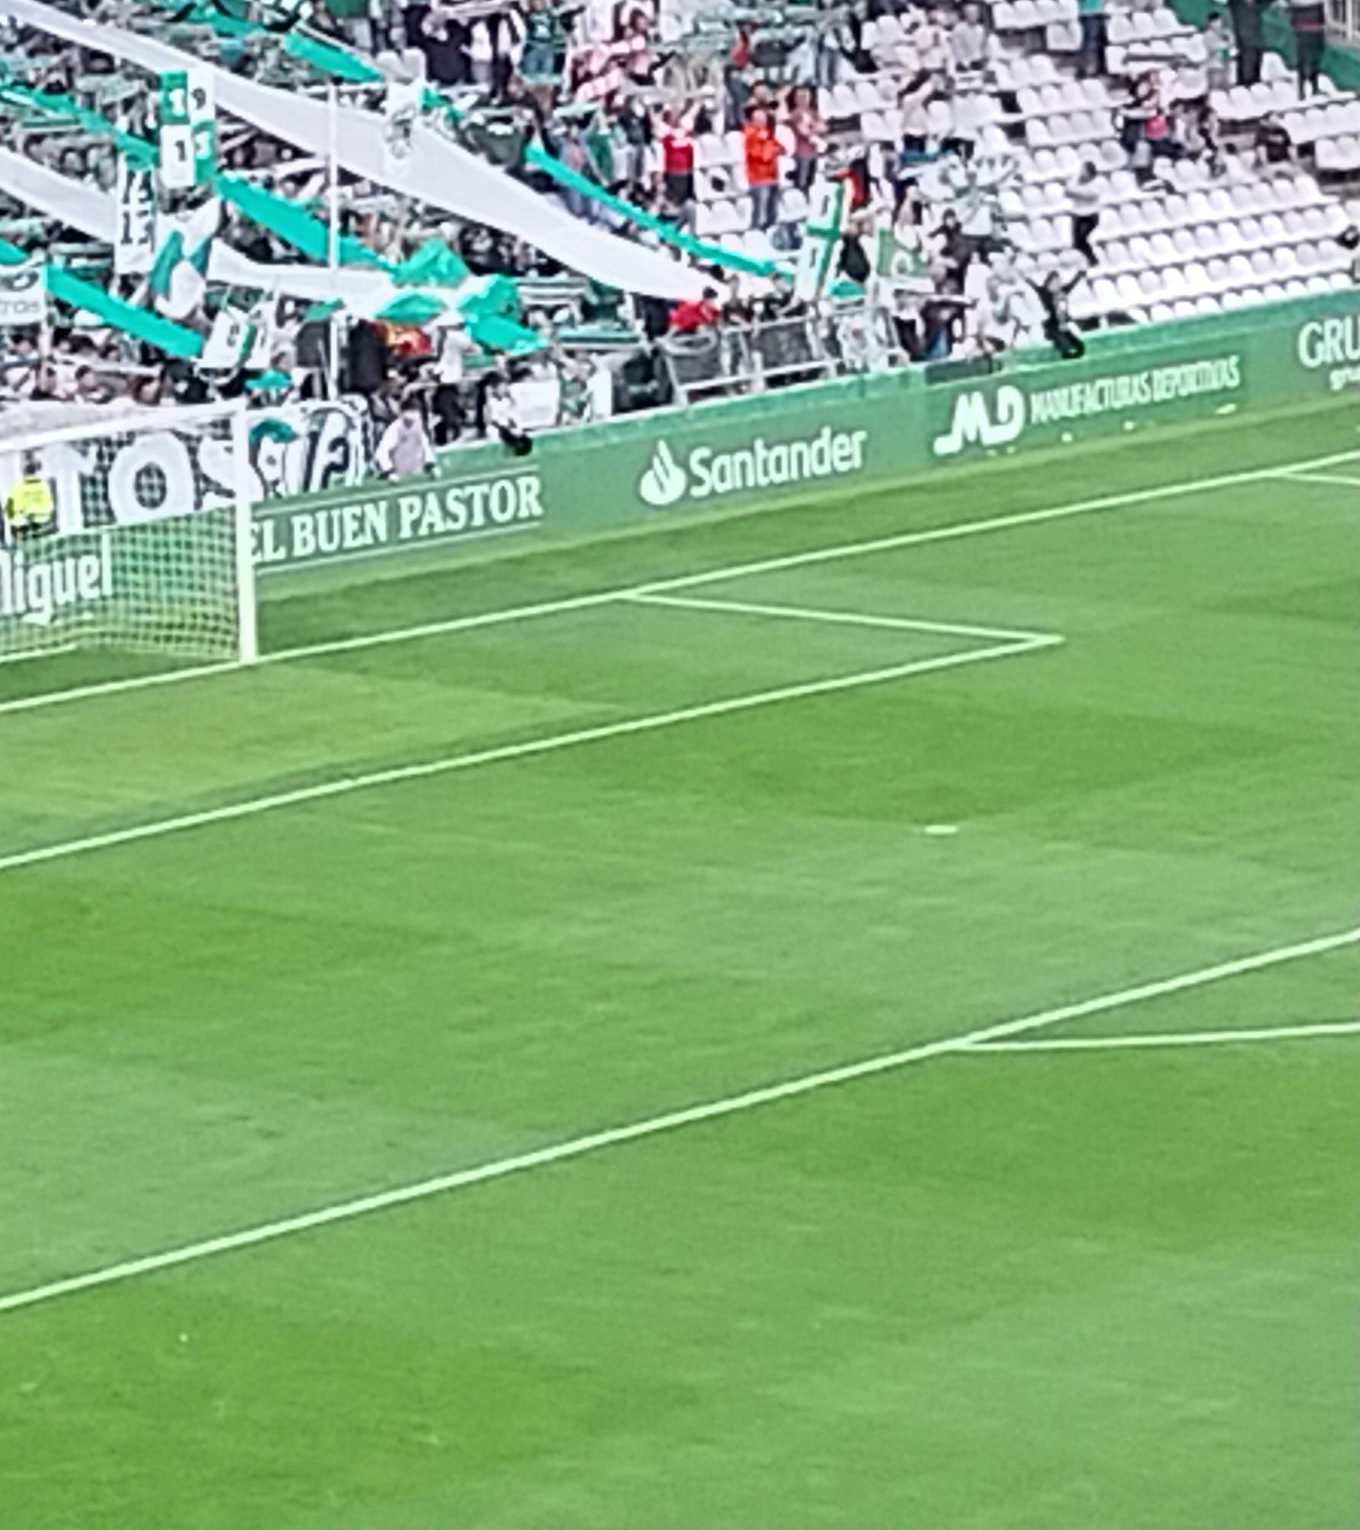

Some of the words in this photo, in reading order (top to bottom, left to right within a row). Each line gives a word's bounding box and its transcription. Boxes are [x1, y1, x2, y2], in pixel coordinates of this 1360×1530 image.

[688, 426, 867, 499] Santander
[294, 500, 386, 557] BUEN
[399, 475, 543, 540] PASTOR
